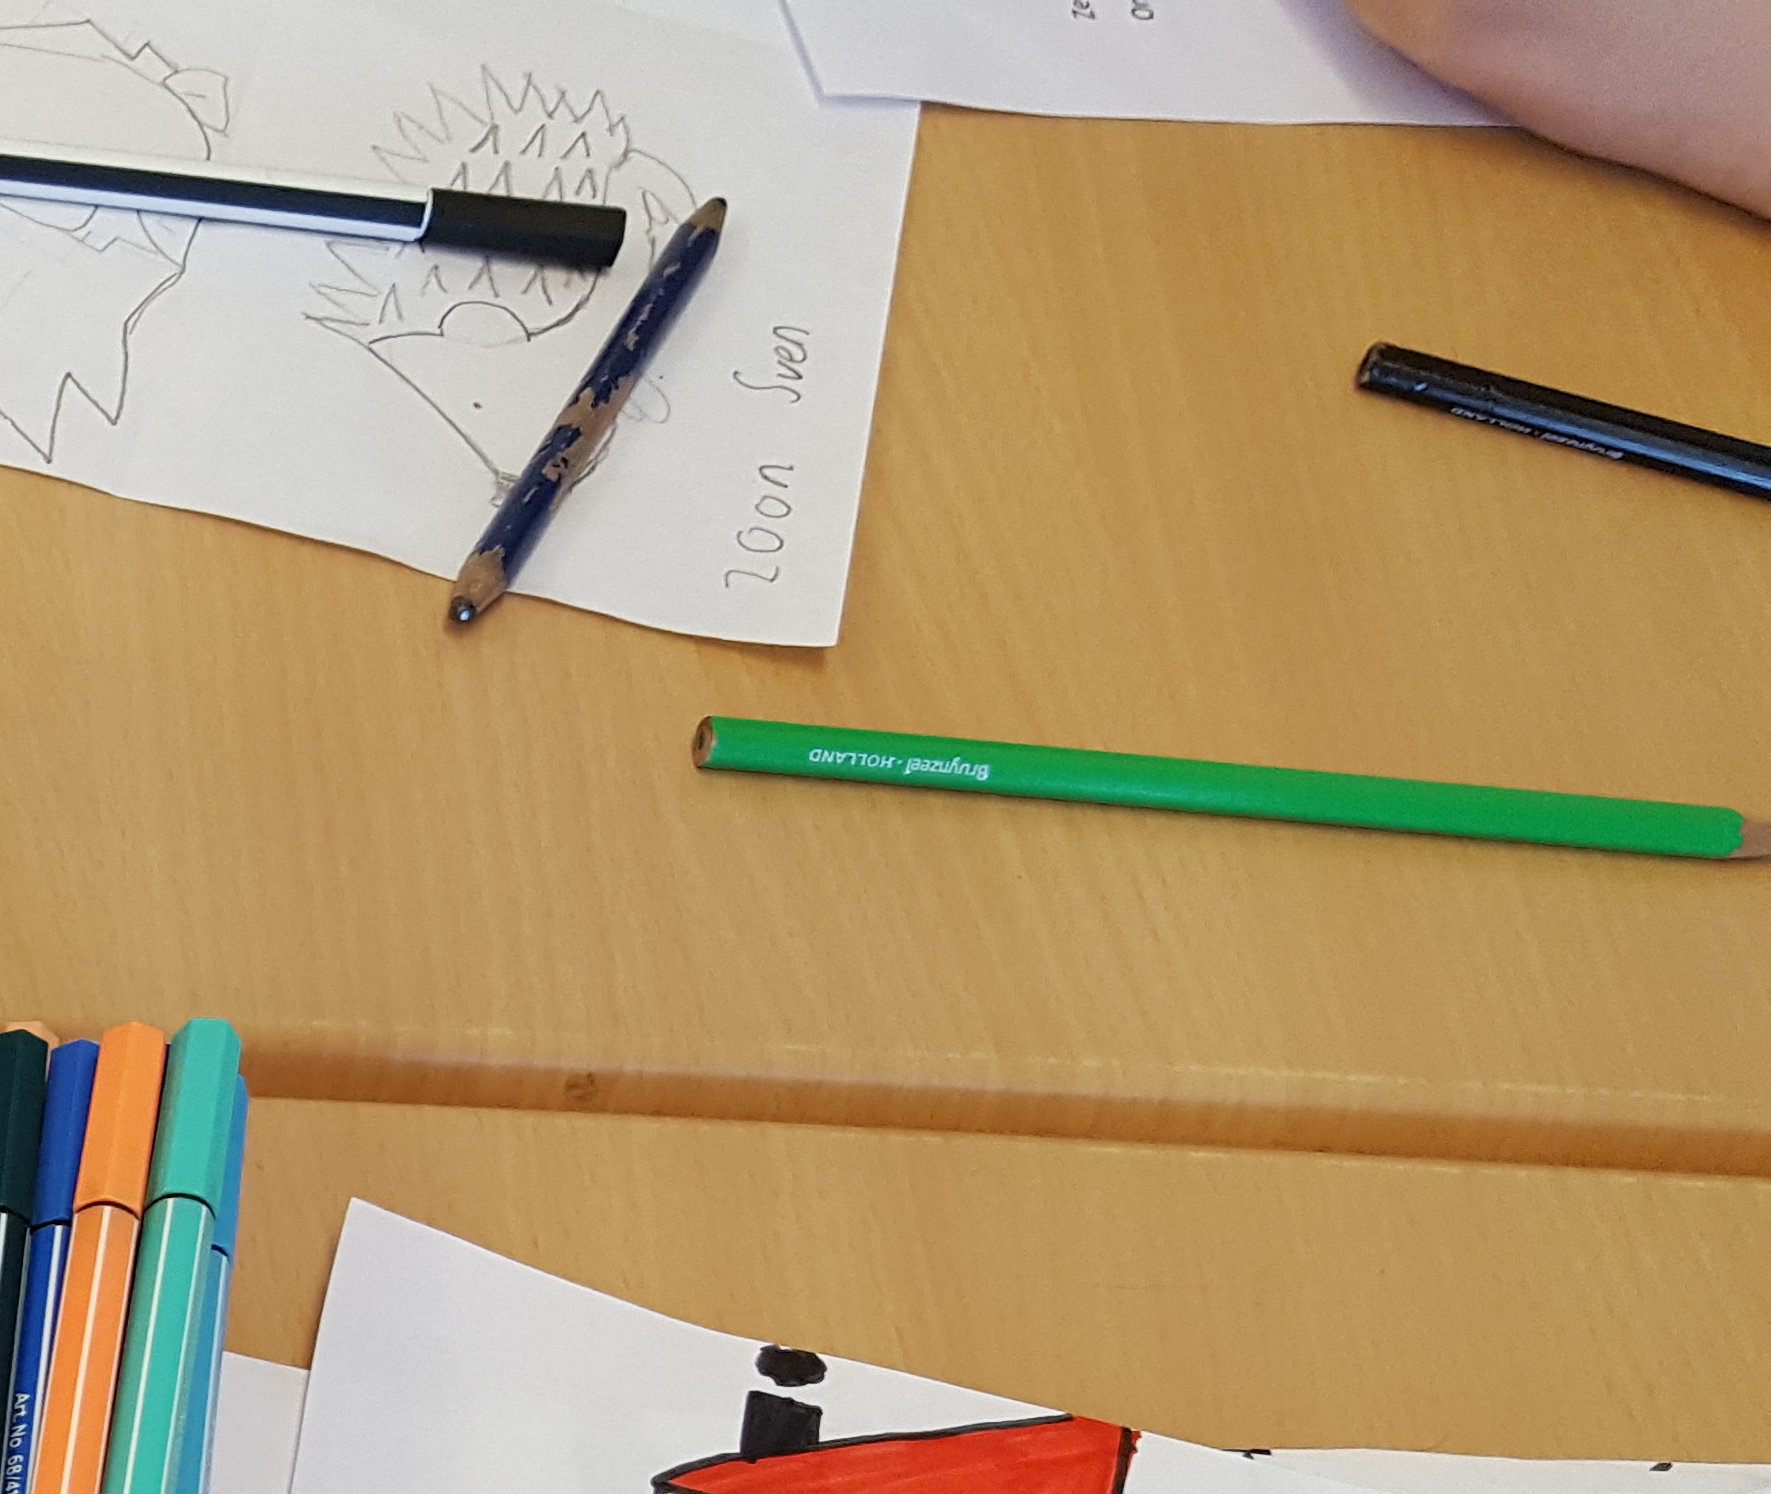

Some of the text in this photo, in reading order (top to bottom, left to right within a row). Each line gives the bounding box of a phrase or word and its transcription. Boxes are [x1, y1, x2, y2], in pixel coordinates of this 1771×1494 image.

[732, 325, 810, 404] Sven
[808, 746, 990, 784] Bruynzeel HOLLAND
